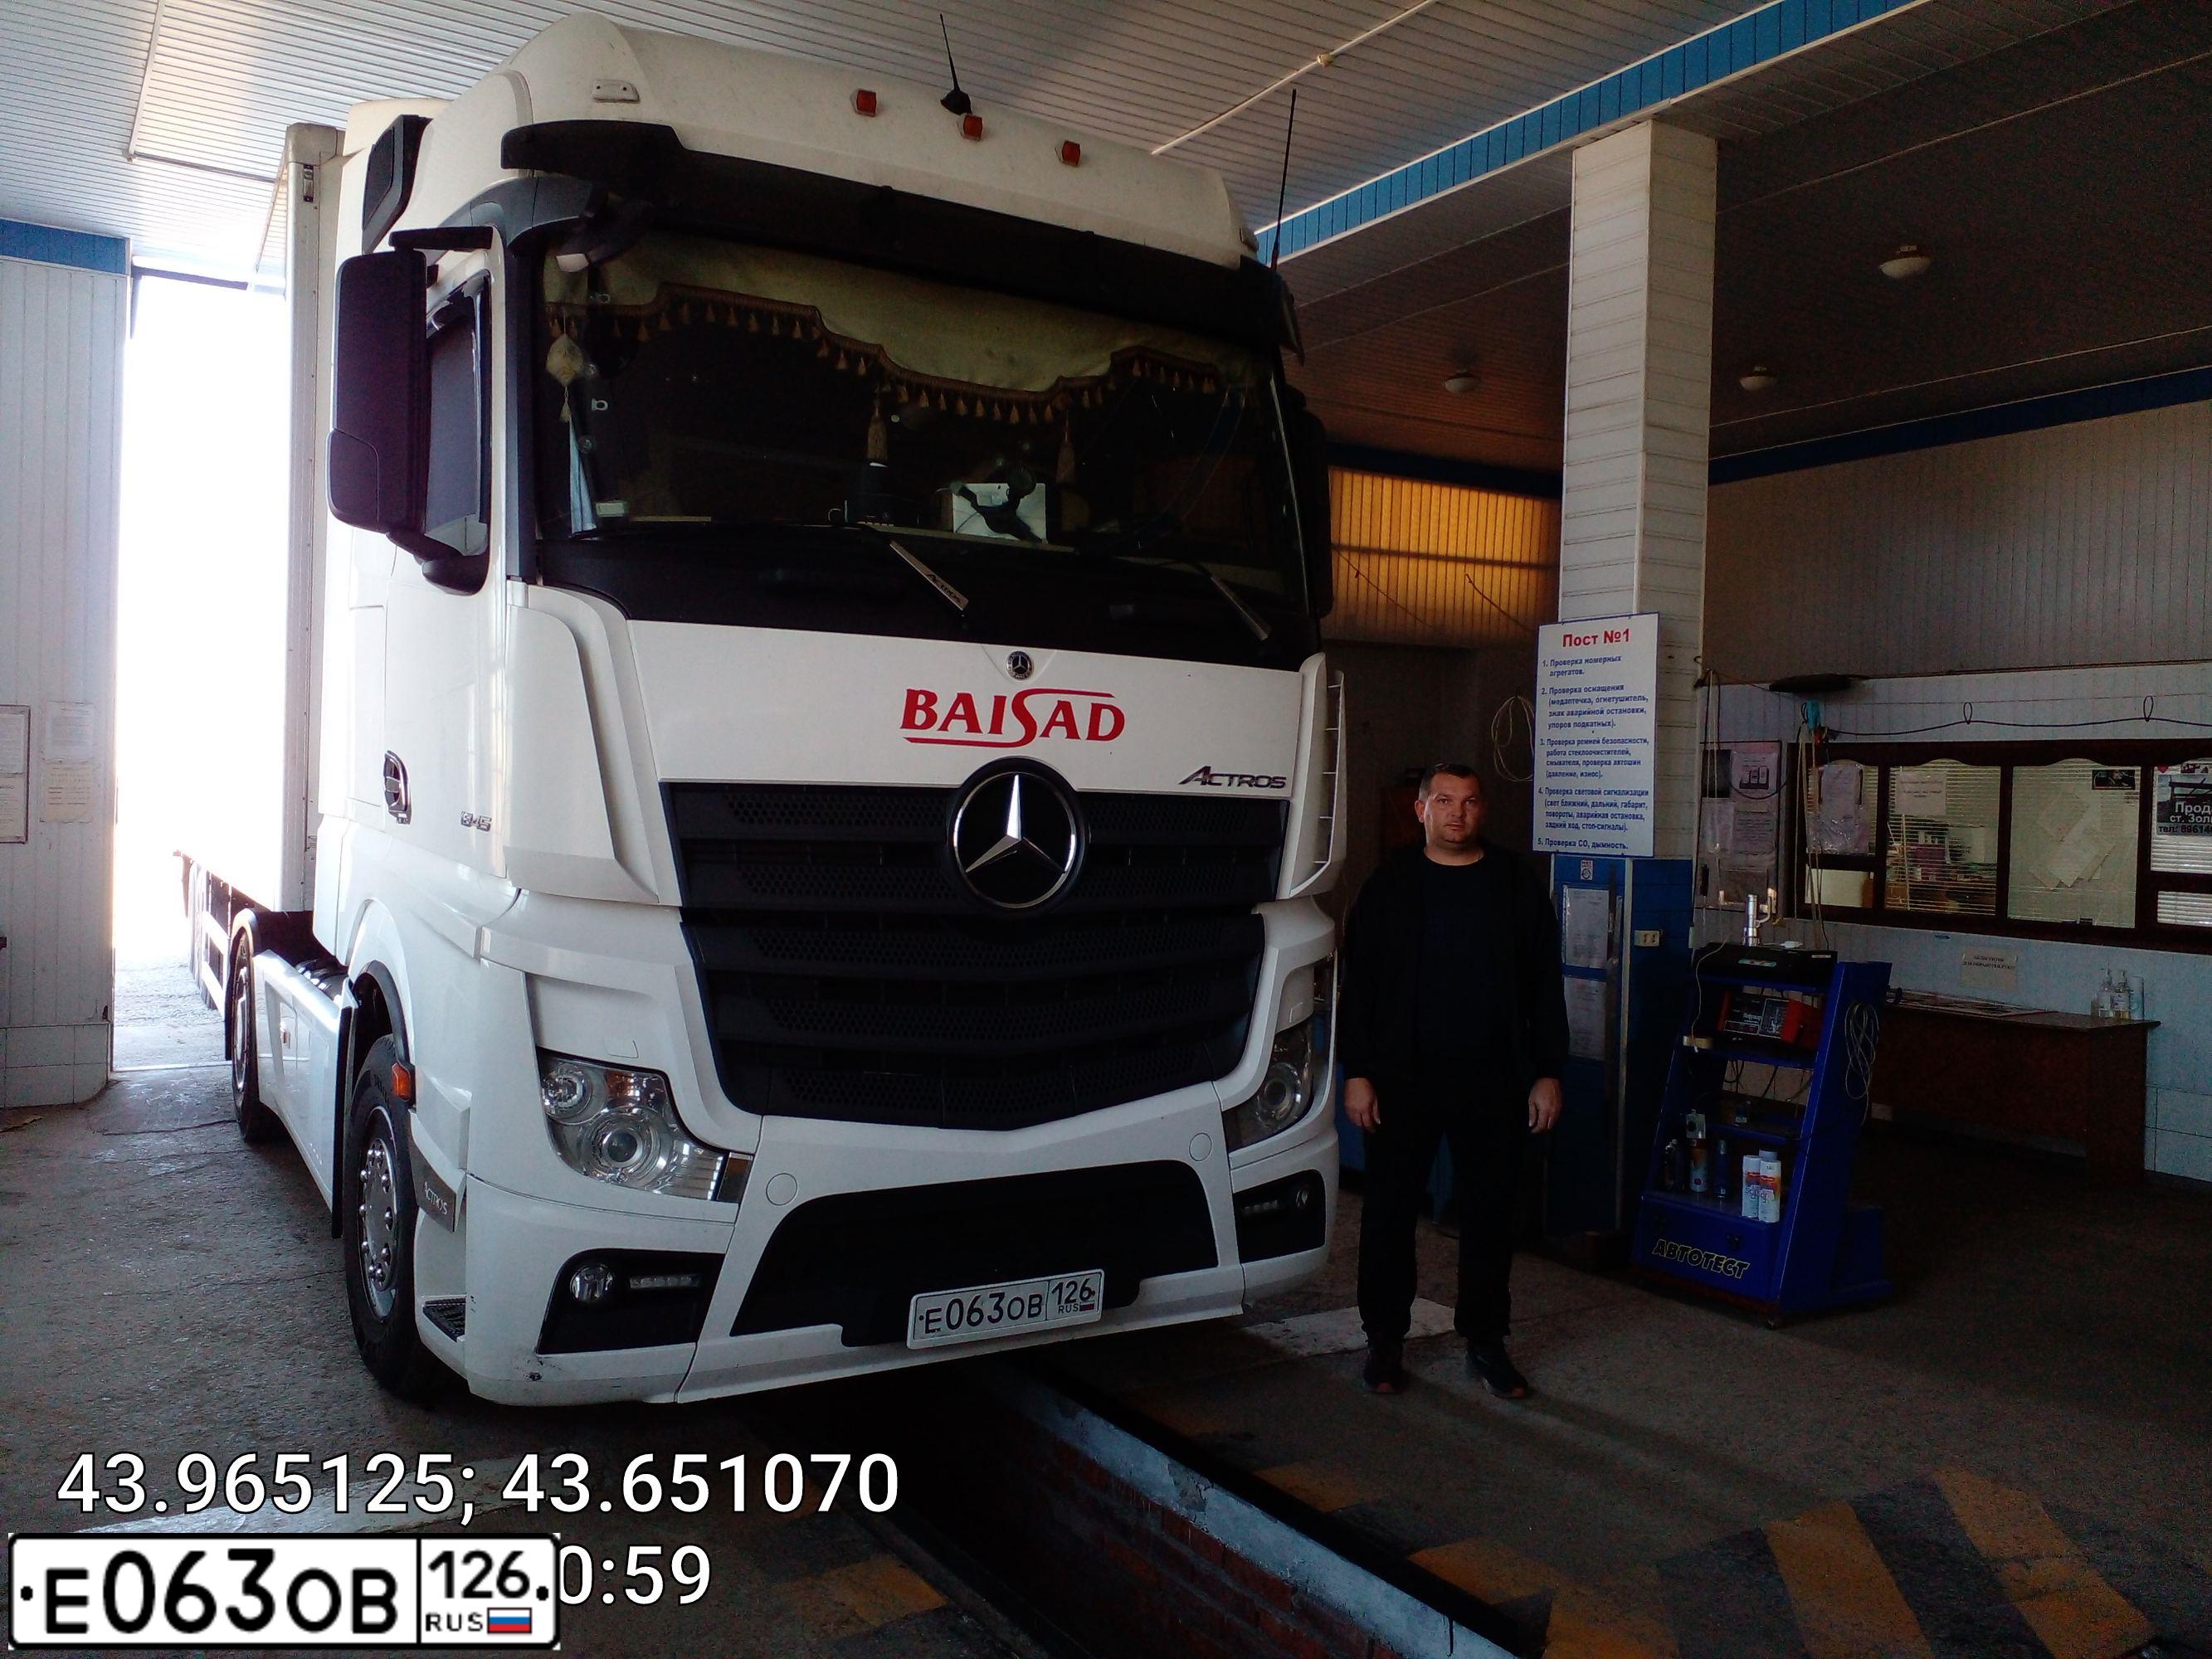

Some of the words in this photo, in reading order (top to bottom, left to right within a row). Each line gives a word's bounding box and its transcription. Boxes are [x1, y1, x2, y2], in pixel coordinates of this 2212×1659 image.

[1562, 633, 1599, 648] Пост
[1603, 628, 1631, 645] №1
[1542, 659, 1548, 668] 1.
[1550, 659, 1582, 668] Проверка
[1585, 655, 1622, 665] номерных
[1549, 669, 1585, 678] агрегатов.
[1549, 687, 1582, 696] Проверка
[1584, 684, 1625, 693] оснащения
[1596, 694, 1649, 704] огнетушитель,
[899, 687, 1126, 748] BAISAD
[1566, 708, 1605, 718] аварийной
[1606, 706, 1647, 715] остановки,
[1547, 722, 1571, 731] упоров
[1547, 738, 1576, 747] Проверка
[1576, 737, 1601, 746] ремней
[1601, 737, 1649, 746] безопасности,
[1546, 749, 1566, 757] работа
[1582, 759, 1611, 767] проверка
[1179, 765, 1288, 790] ACTROS
[1545, 787, 1573, 796] Проверка
[1575, 787, 1602, 795] световой
[1603, 789, 1649, 797] сигнализации
[1544, 799, 1560, 808] (свет
[1561, 799, 1590, 808] ближний,
[1591, 800, 1619, 809] дальний,
[2175, 800, 2212, 816] Прод
[1545, 810, 1575, 819] повороты,
[1576, 810, 1609, 820] аварийная
[1545, 820, 1566, 829] задний
[1545, 838, 1576, 848] Проверка
[1591, 842, 1629, 850] дымность.
[1651, 1238, 1751, 1279] АВТОТЕСТ
[1051, 1277, 1092, 1306] 126
[1058, 1303, 1079, 1314] RUS
